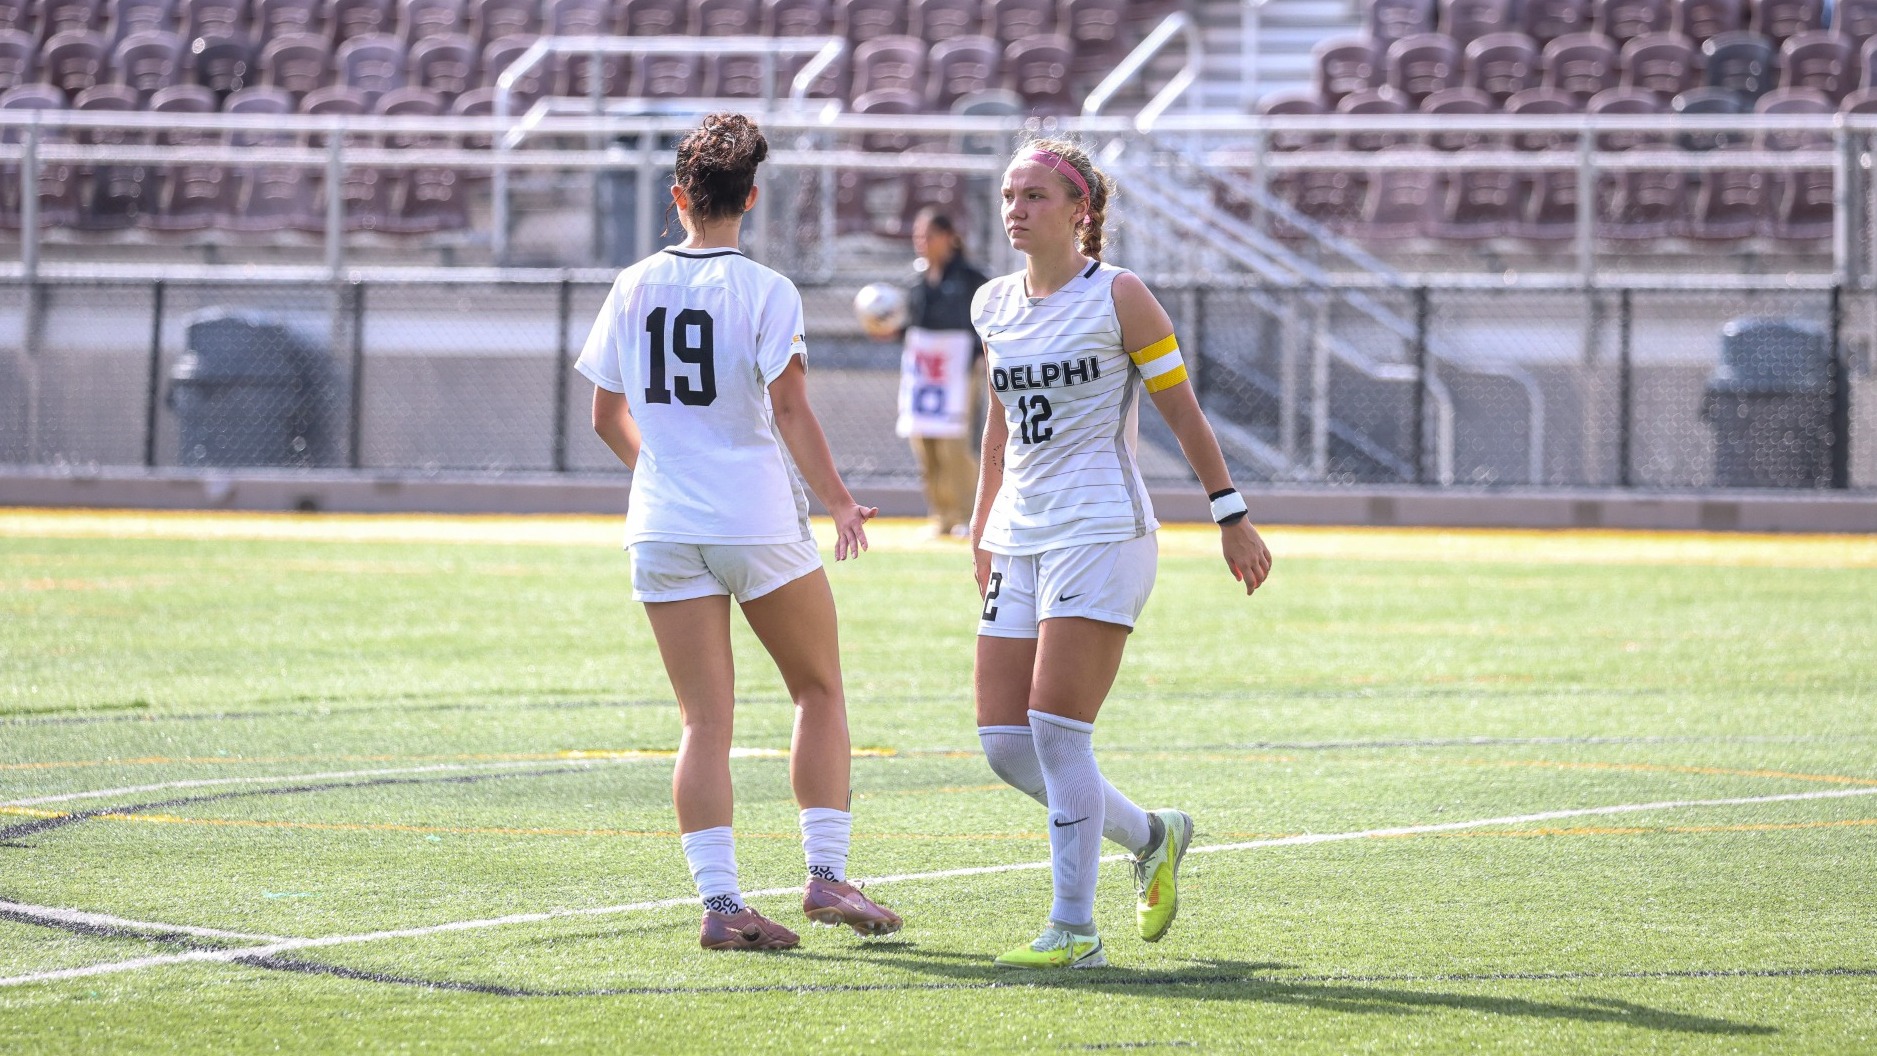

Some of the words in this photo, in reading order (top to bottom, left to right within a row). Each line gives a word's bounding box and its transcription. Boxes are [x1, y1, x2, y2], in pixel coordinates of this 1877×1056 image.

[645, 306, 717, 406] 19
[991, 355, 1101, 392] DELPHI
[1018, 395, 1053, 444] 12
